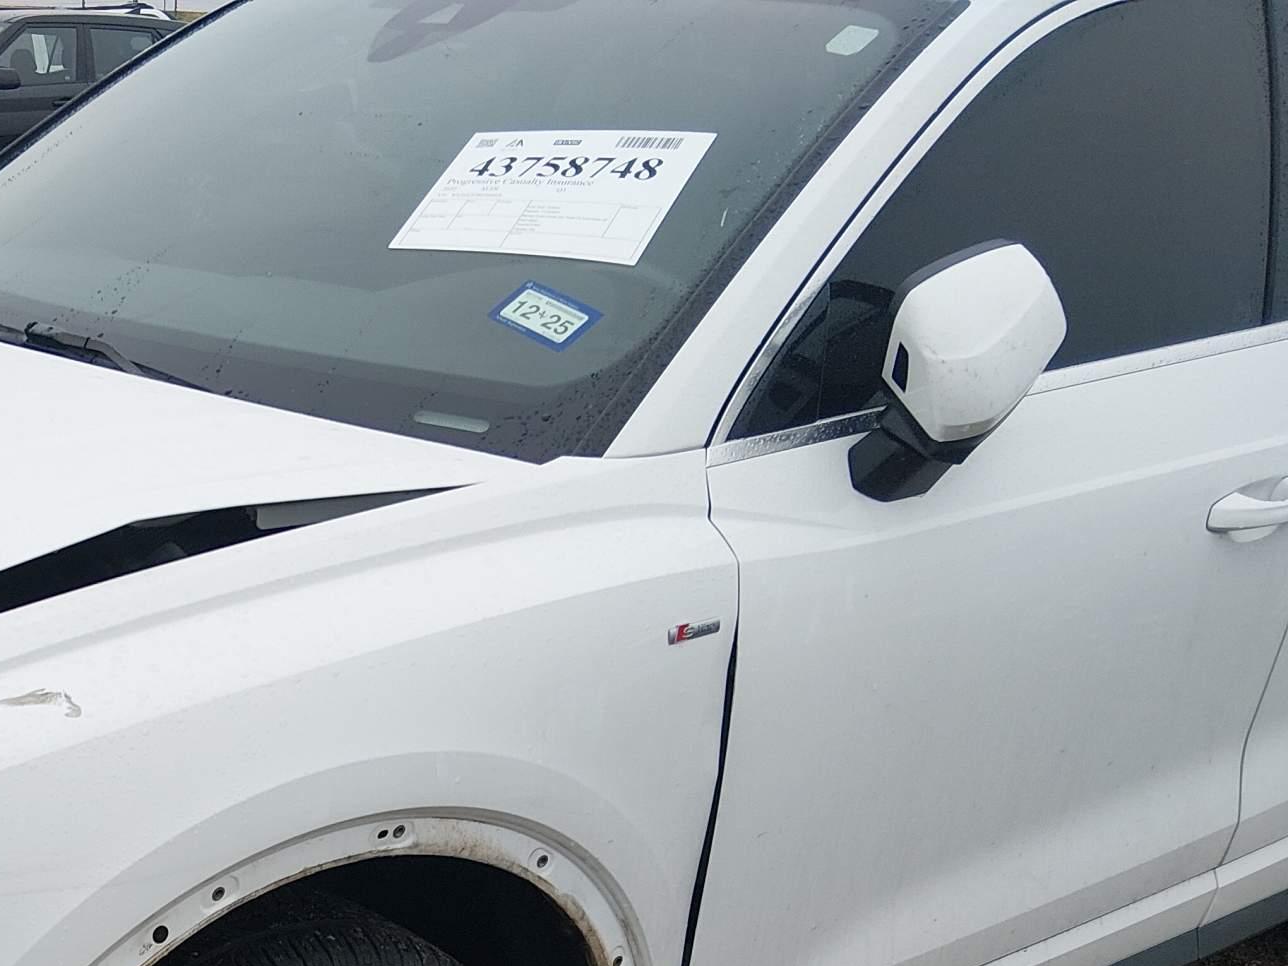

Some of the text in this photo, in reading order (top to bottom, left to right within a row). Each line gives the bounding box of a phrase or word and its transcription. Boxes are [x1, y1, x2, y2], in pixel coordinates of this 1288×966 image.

[469, 156, 665, 181] 43758748
[511, 299, 541, 321] 12
[540, 313, 575, 336] 25
